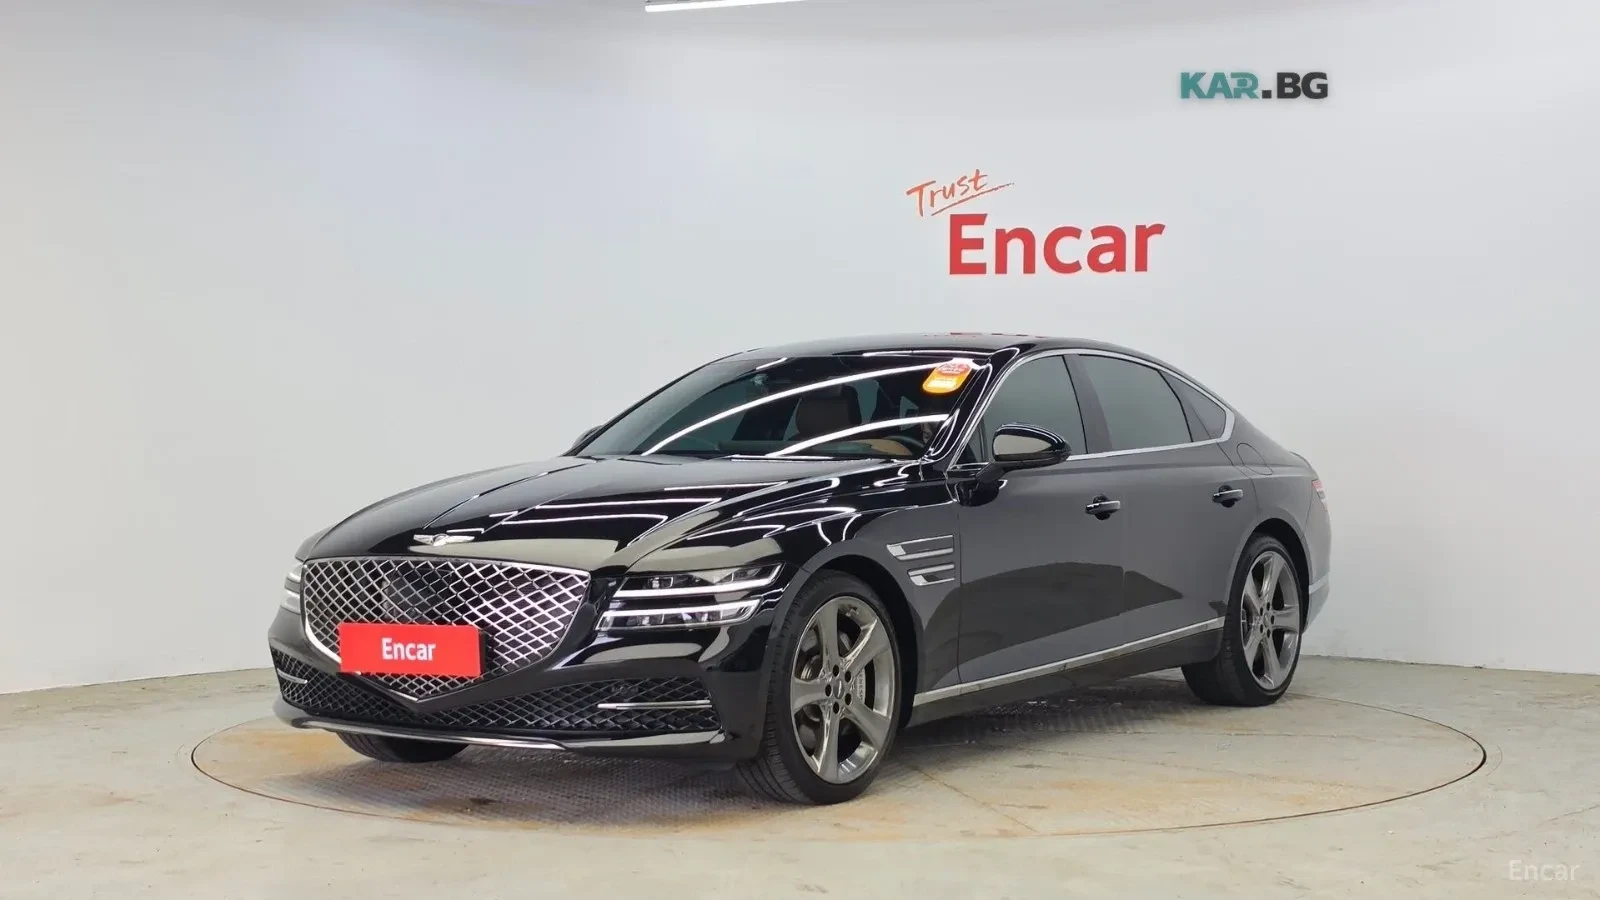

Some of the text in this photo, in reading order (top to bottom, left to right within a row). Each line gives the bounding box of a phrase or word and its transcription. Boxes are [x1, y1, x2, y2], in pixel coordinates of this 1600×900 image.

[906, 169, 990, 217] Trust
[949, 213, 1166, 275] Encar
[382, 637, 436, 661] Encar
